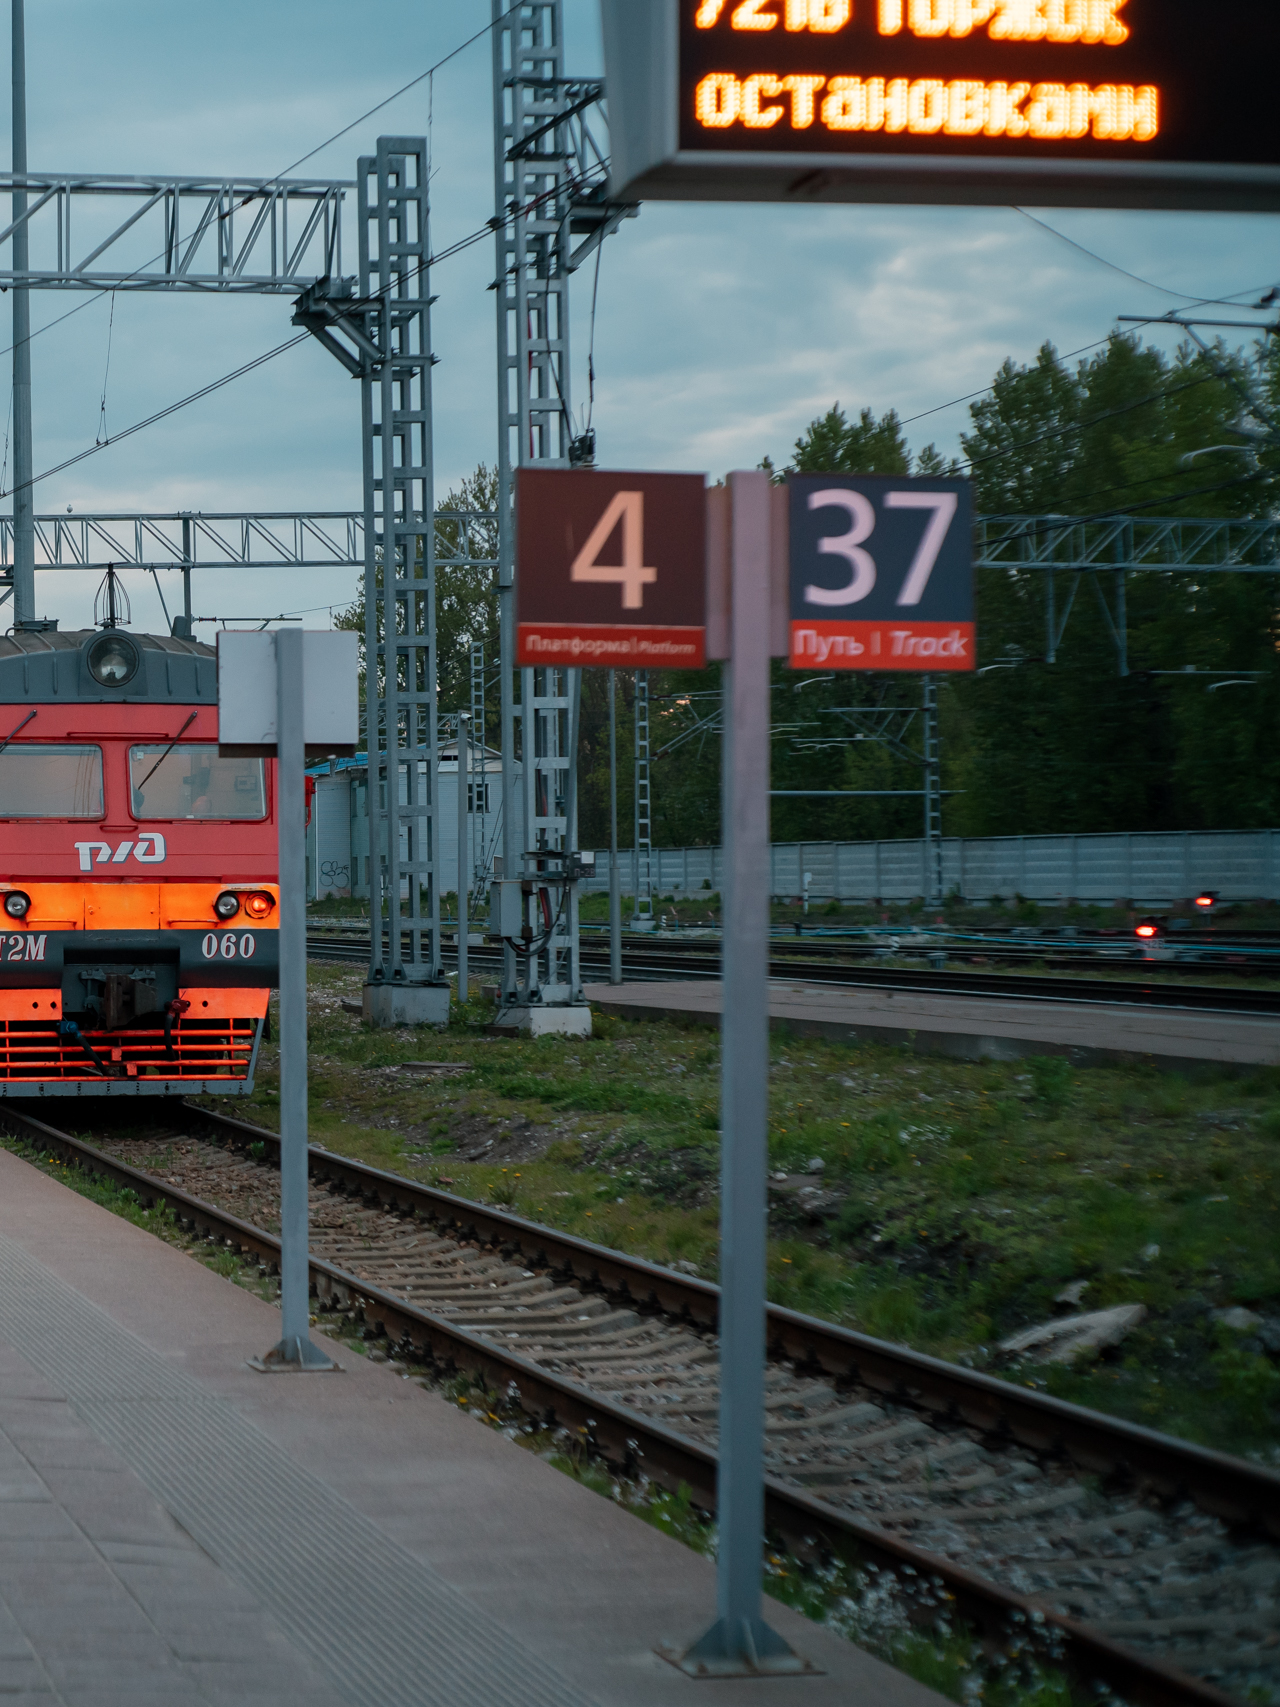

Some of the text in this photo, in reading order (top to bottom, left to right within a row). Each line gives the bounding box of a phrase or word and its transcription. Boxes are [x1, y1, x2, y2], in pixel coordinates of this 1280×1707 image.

[570, 490, 658, 609] 4
[804, 488, 958, 606] 37
[525, 634, 696, 656] Платформа Platform
[794, 629, 969, 662] Путь Track
[201, 933, 256, 959] 060
